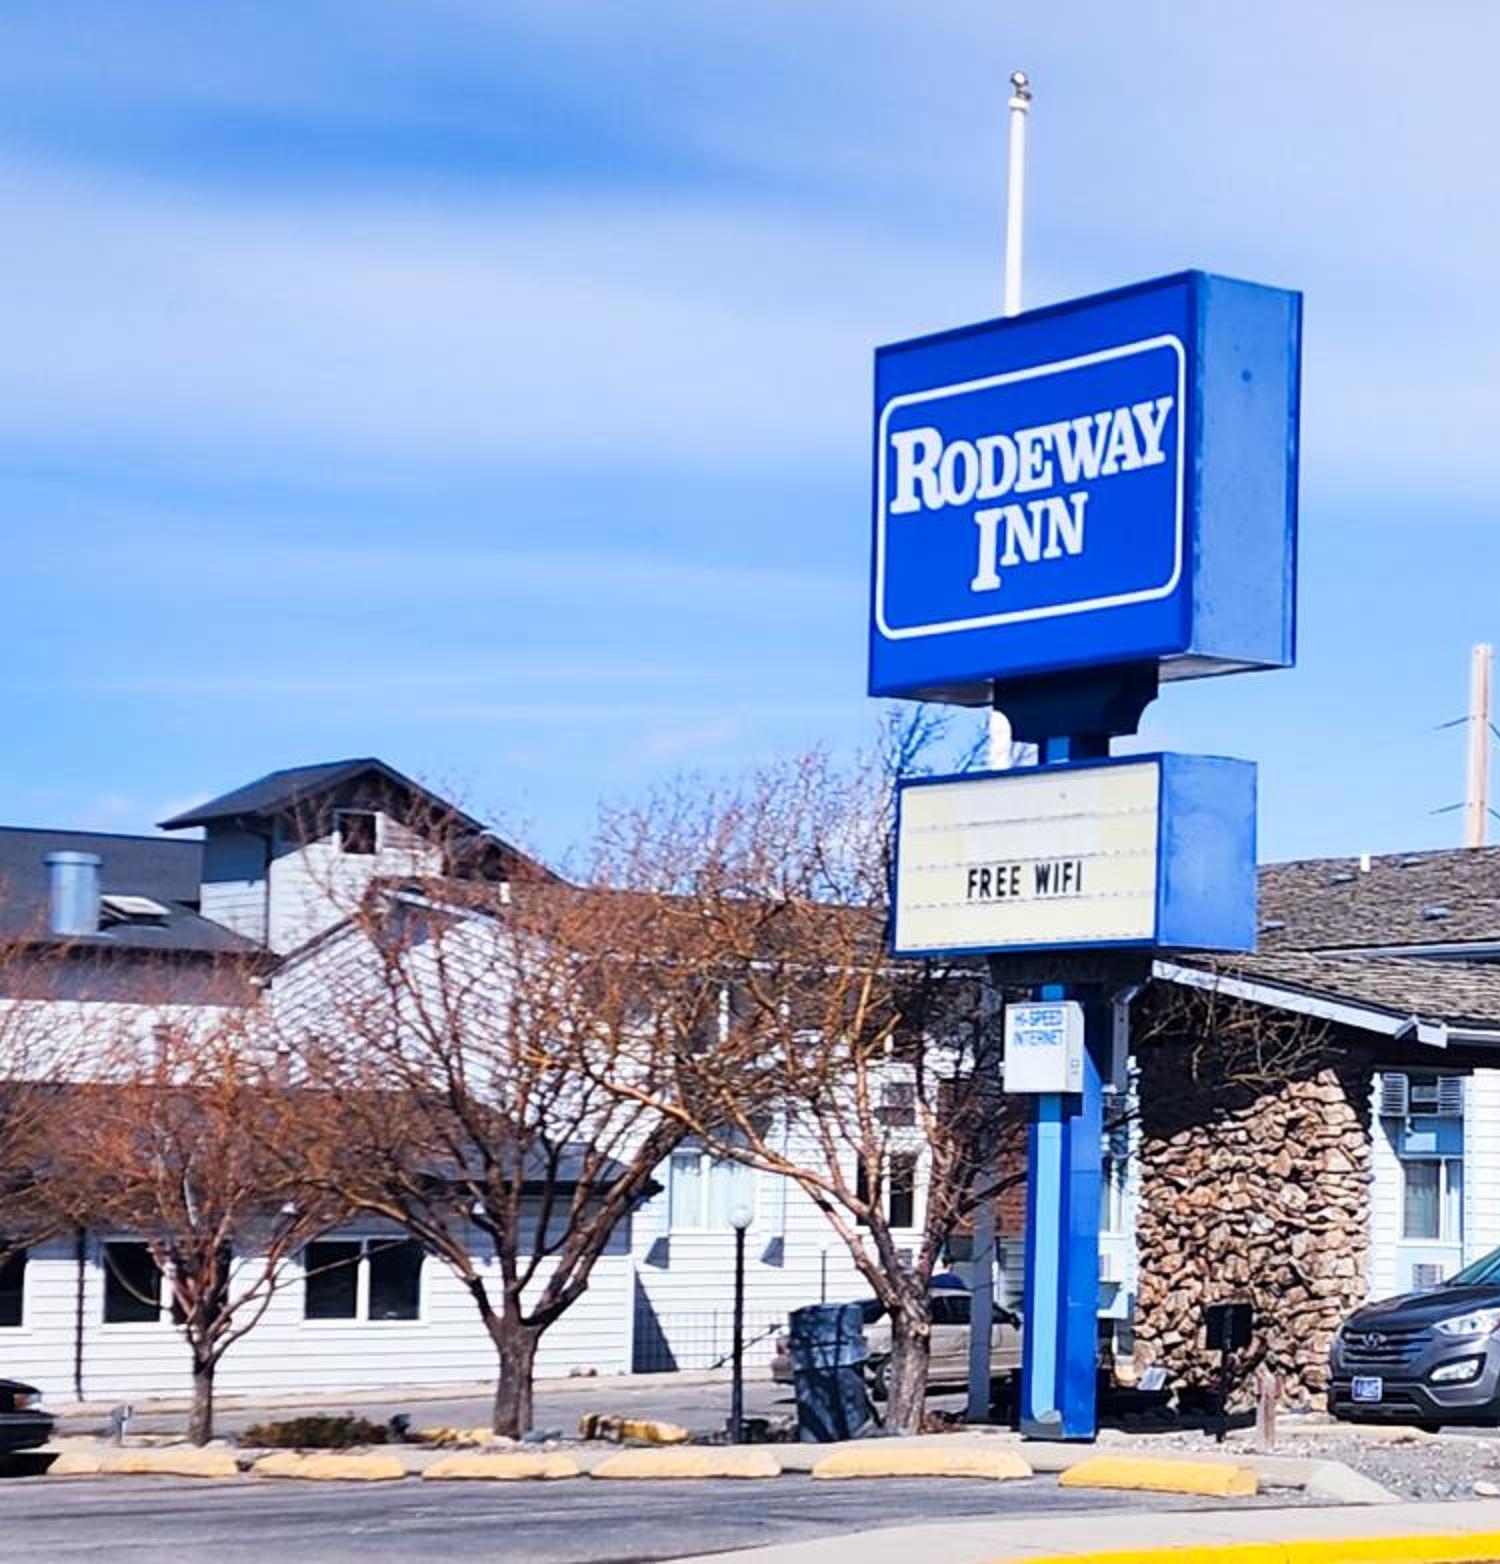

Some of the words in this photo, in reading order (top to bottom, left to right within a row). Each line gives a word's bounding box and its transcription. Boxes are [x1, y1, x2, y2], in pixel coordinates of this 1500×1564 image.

[889, 396, 1174, 514] RODEWAY
[970, 491, 1089, 592] INN
[966, 865, 1021, 899] FREE
[1035, 860, 1083, 894] WIFI
